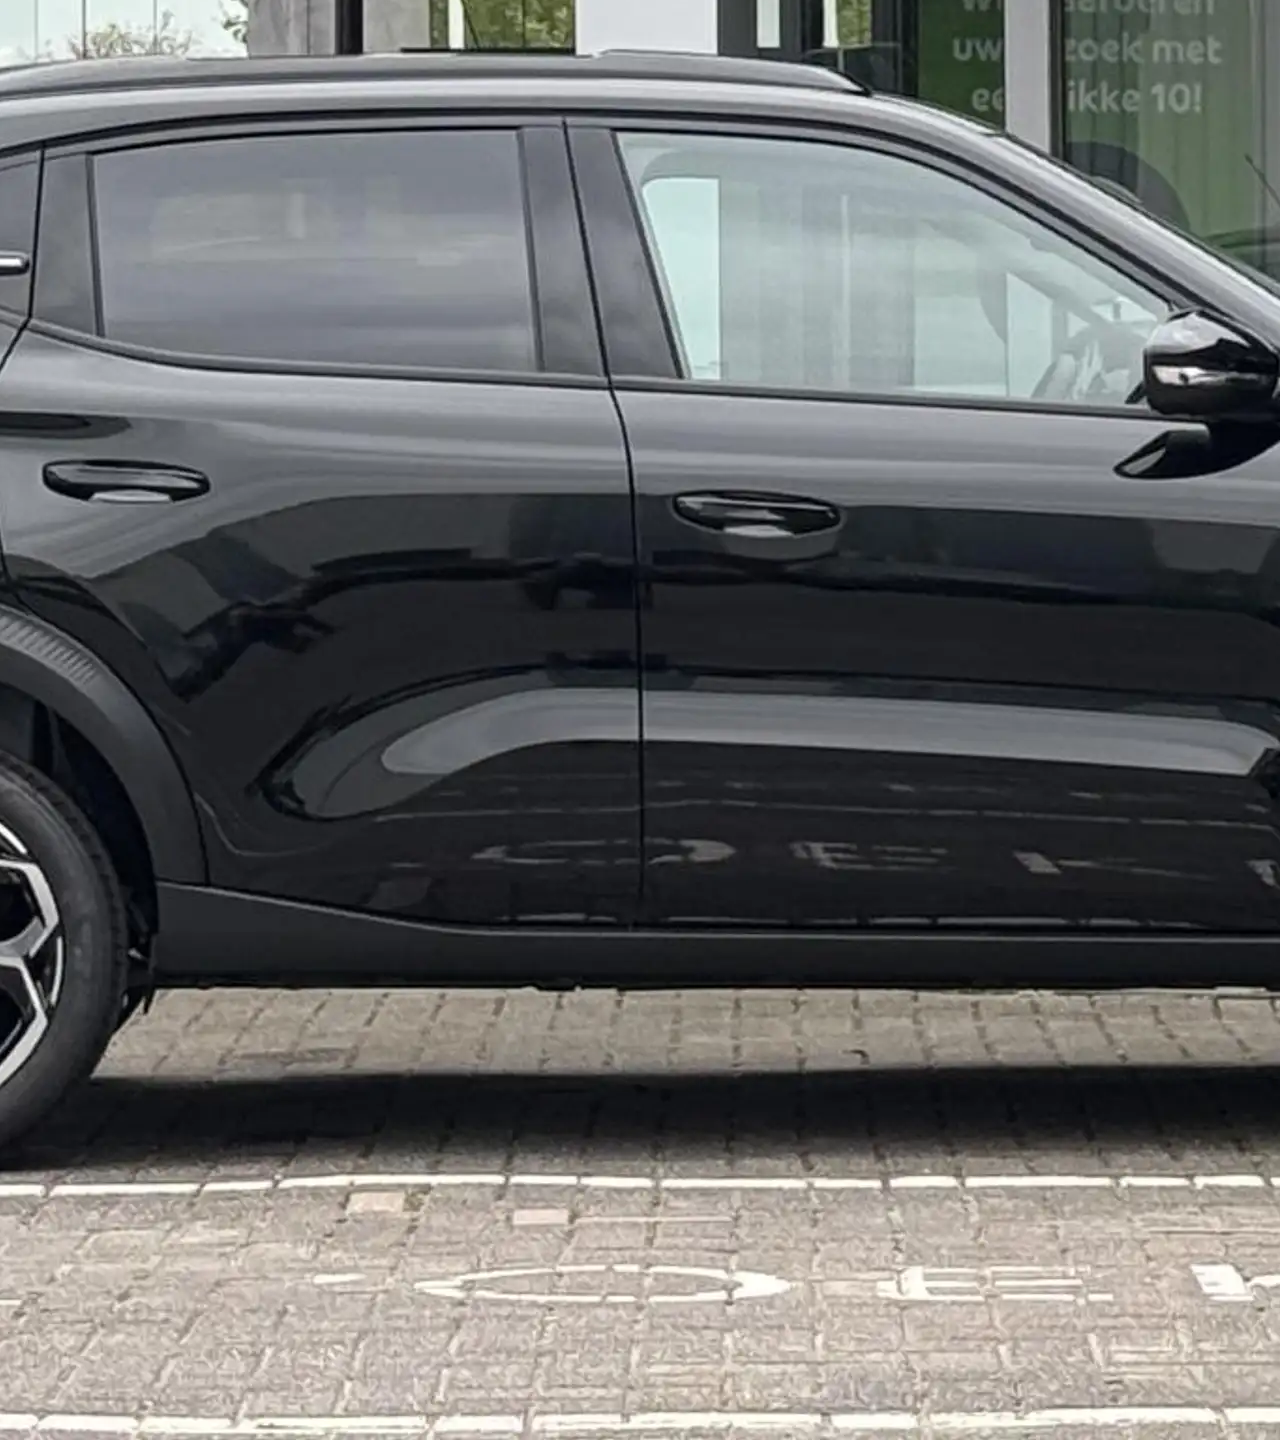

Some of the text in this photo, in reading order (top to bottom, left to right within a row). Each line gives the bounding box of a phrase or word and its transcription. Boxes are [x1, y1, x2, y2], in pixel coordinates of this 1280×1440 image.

[1064, 31, 1145, 62] zoek
[1151, 35, 1222, 64] met
[971, 78, 1203, 114] ee ikke 10!
